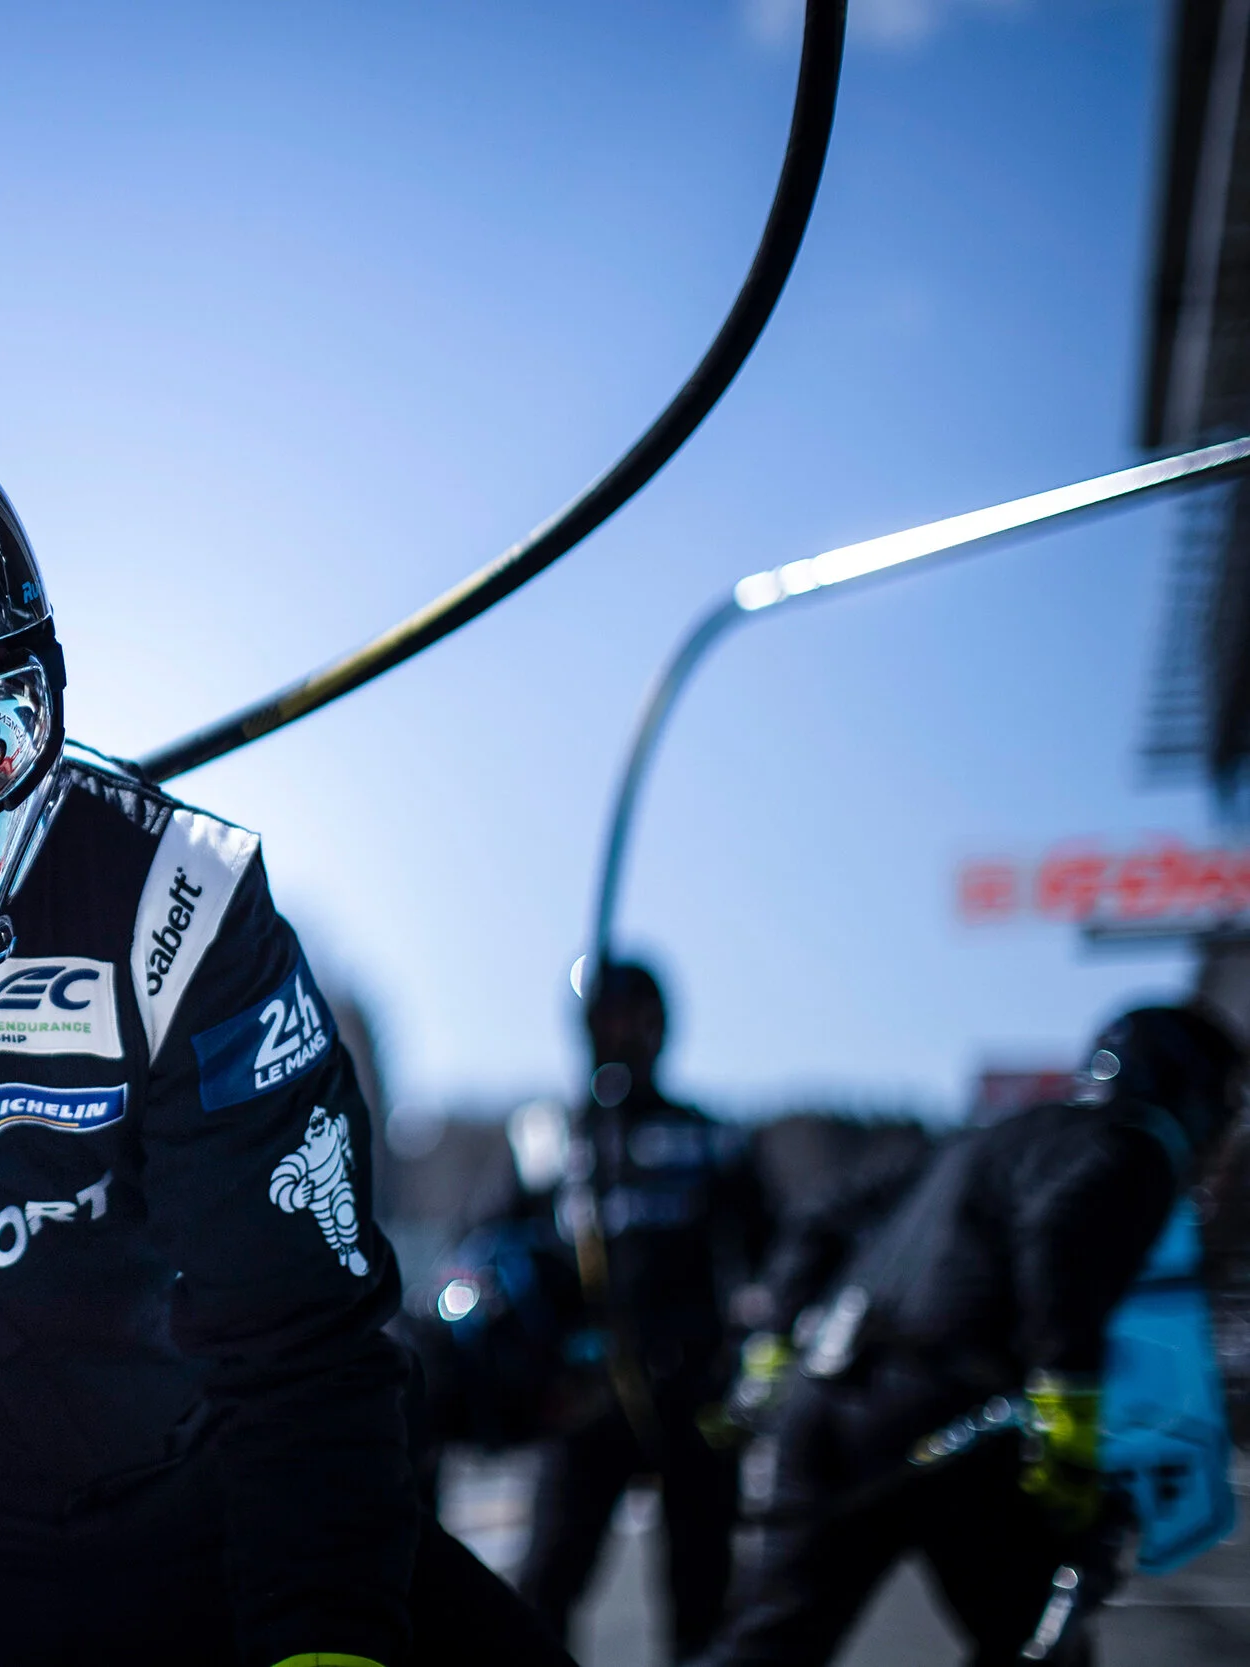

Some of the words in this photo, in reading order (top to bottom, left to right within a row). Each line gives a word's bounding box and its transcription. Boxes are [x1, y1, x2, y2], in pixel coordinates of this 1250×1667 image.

[253, 973, 321, 1070] 24h
[254, 1062, 284, 1090] LE
[285, 1029, 327, 1076] MANS
